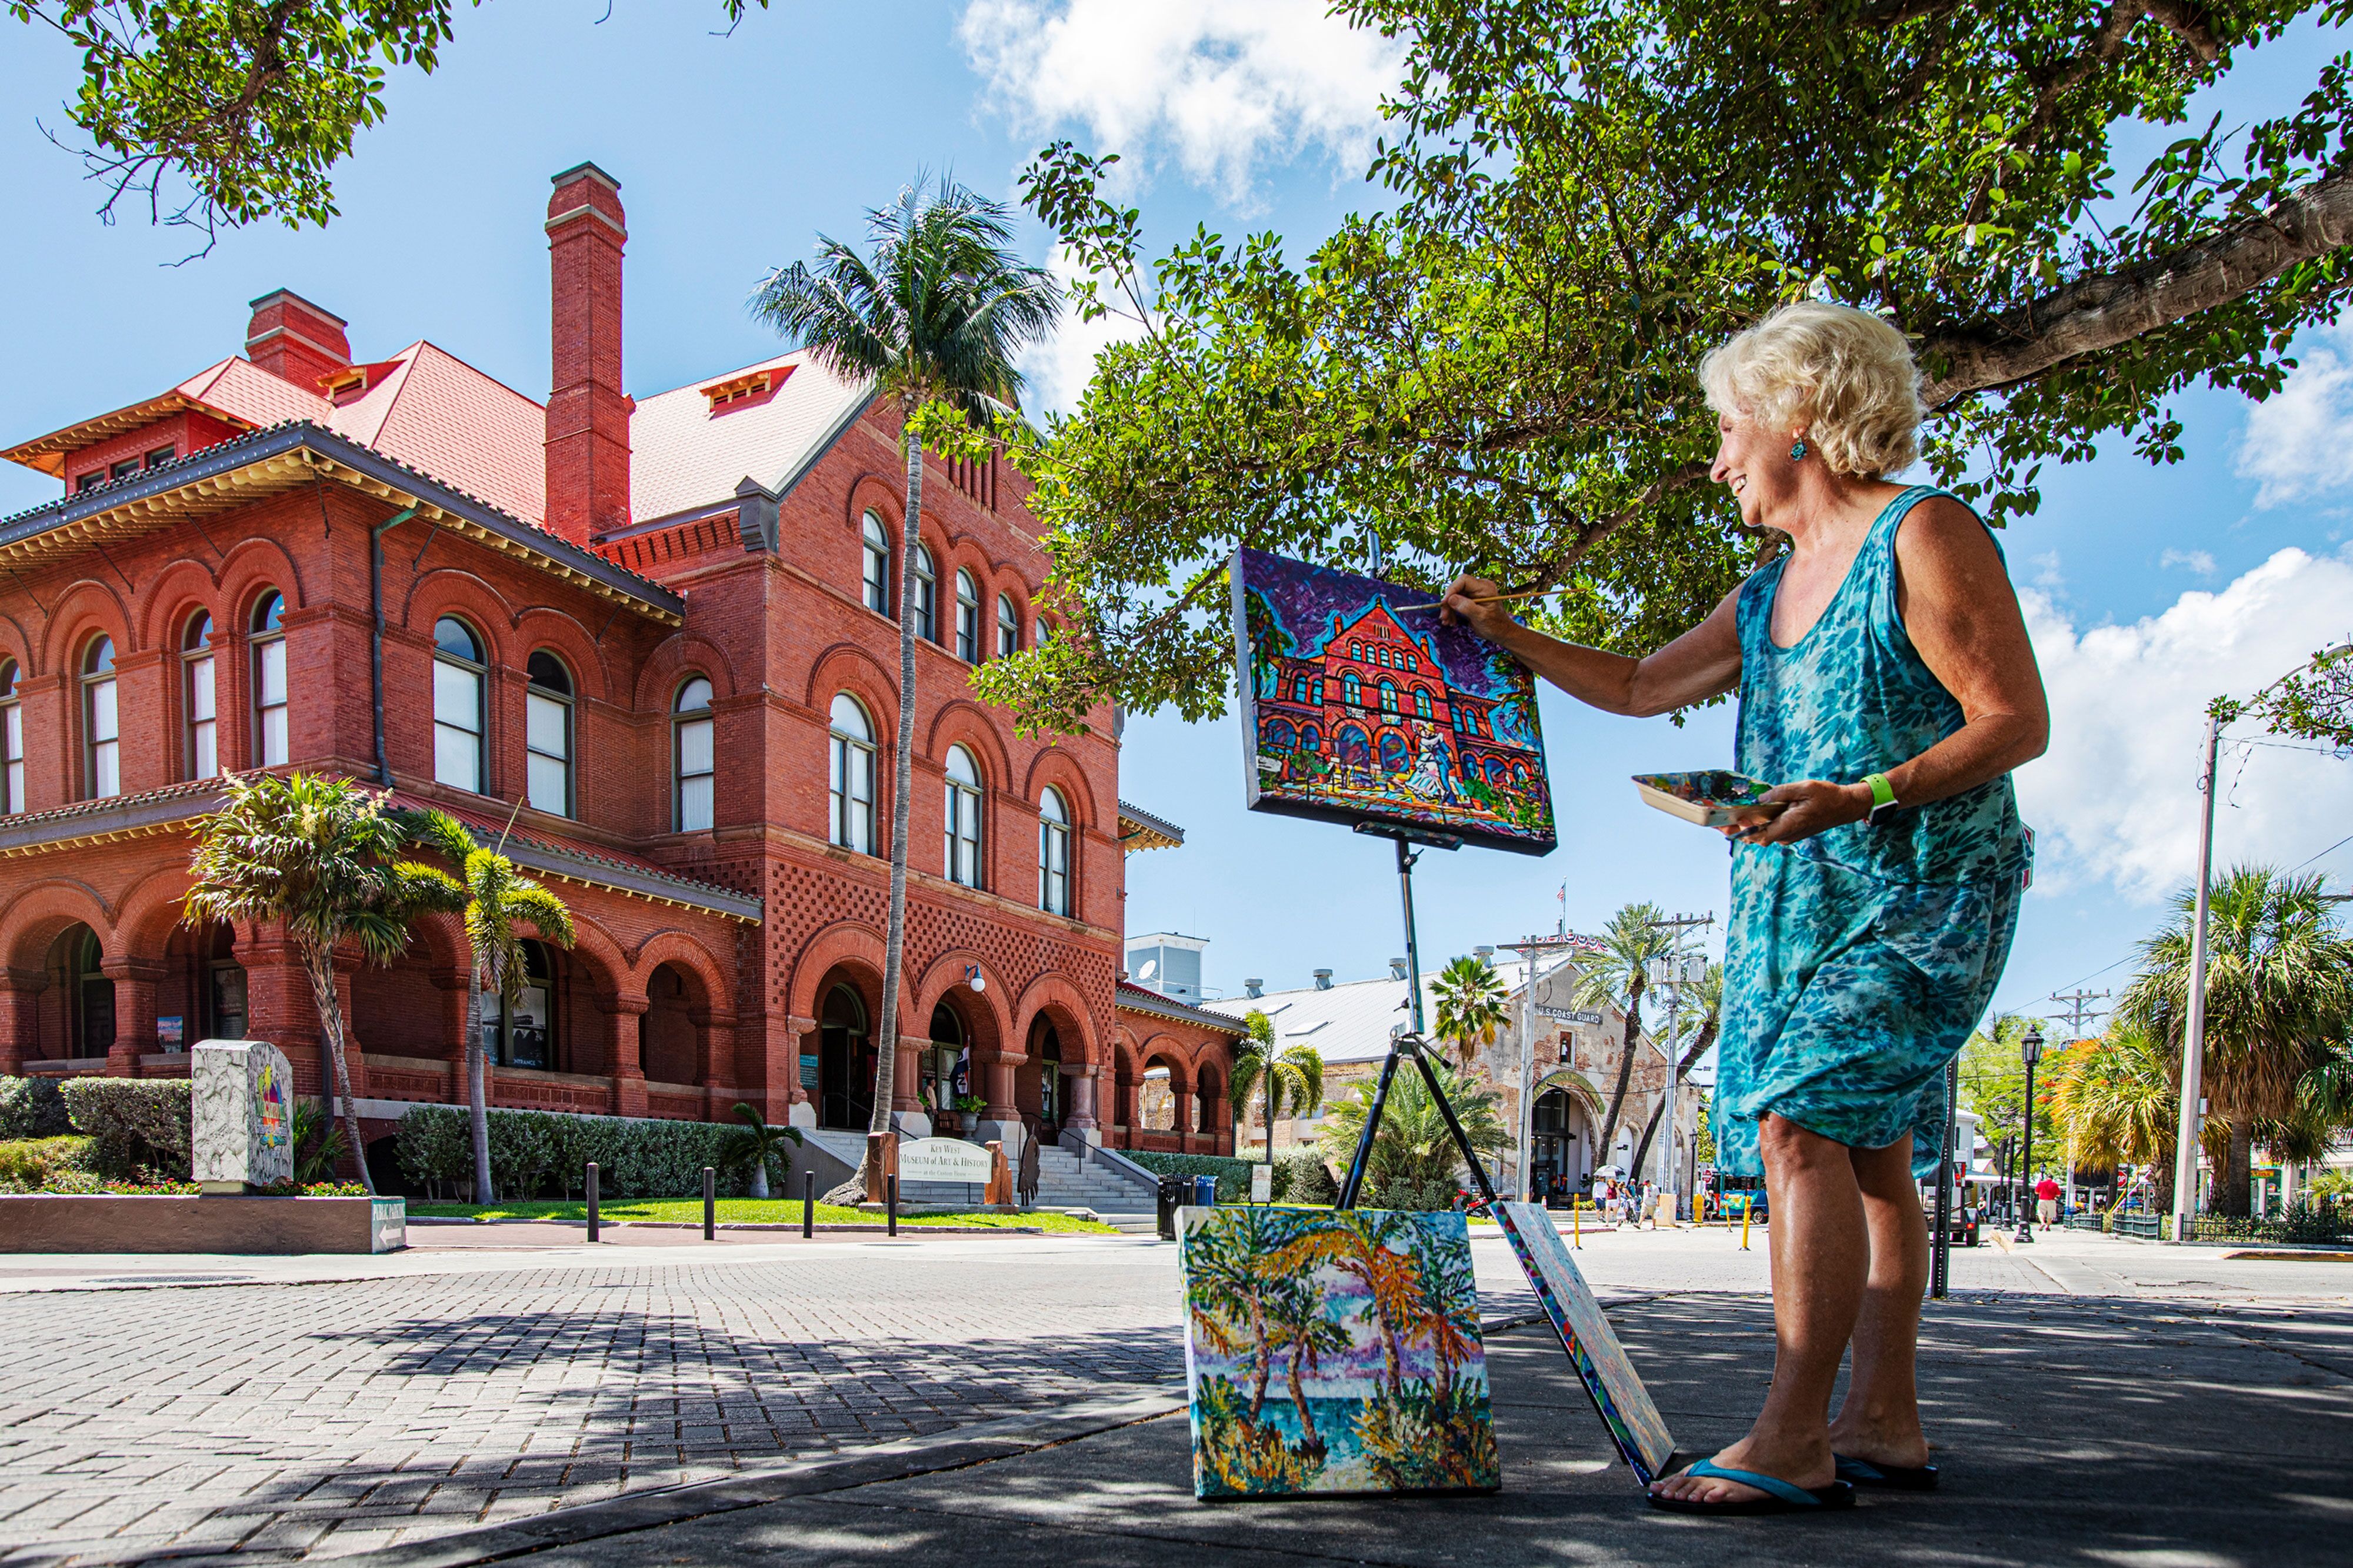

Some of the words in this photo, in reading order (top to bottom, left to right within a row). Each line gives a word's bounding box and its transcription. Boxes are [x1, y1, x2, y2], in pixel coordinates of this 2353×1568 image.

[1552, 1009, 1577, 1020] COAST
[1577, 1012, 1599, 1023] GUARD
[931, 1156, 937, 1165] of
[953, 1157, 959, 1166] &
[373, 1203, 389, 1221] PUBLIC
